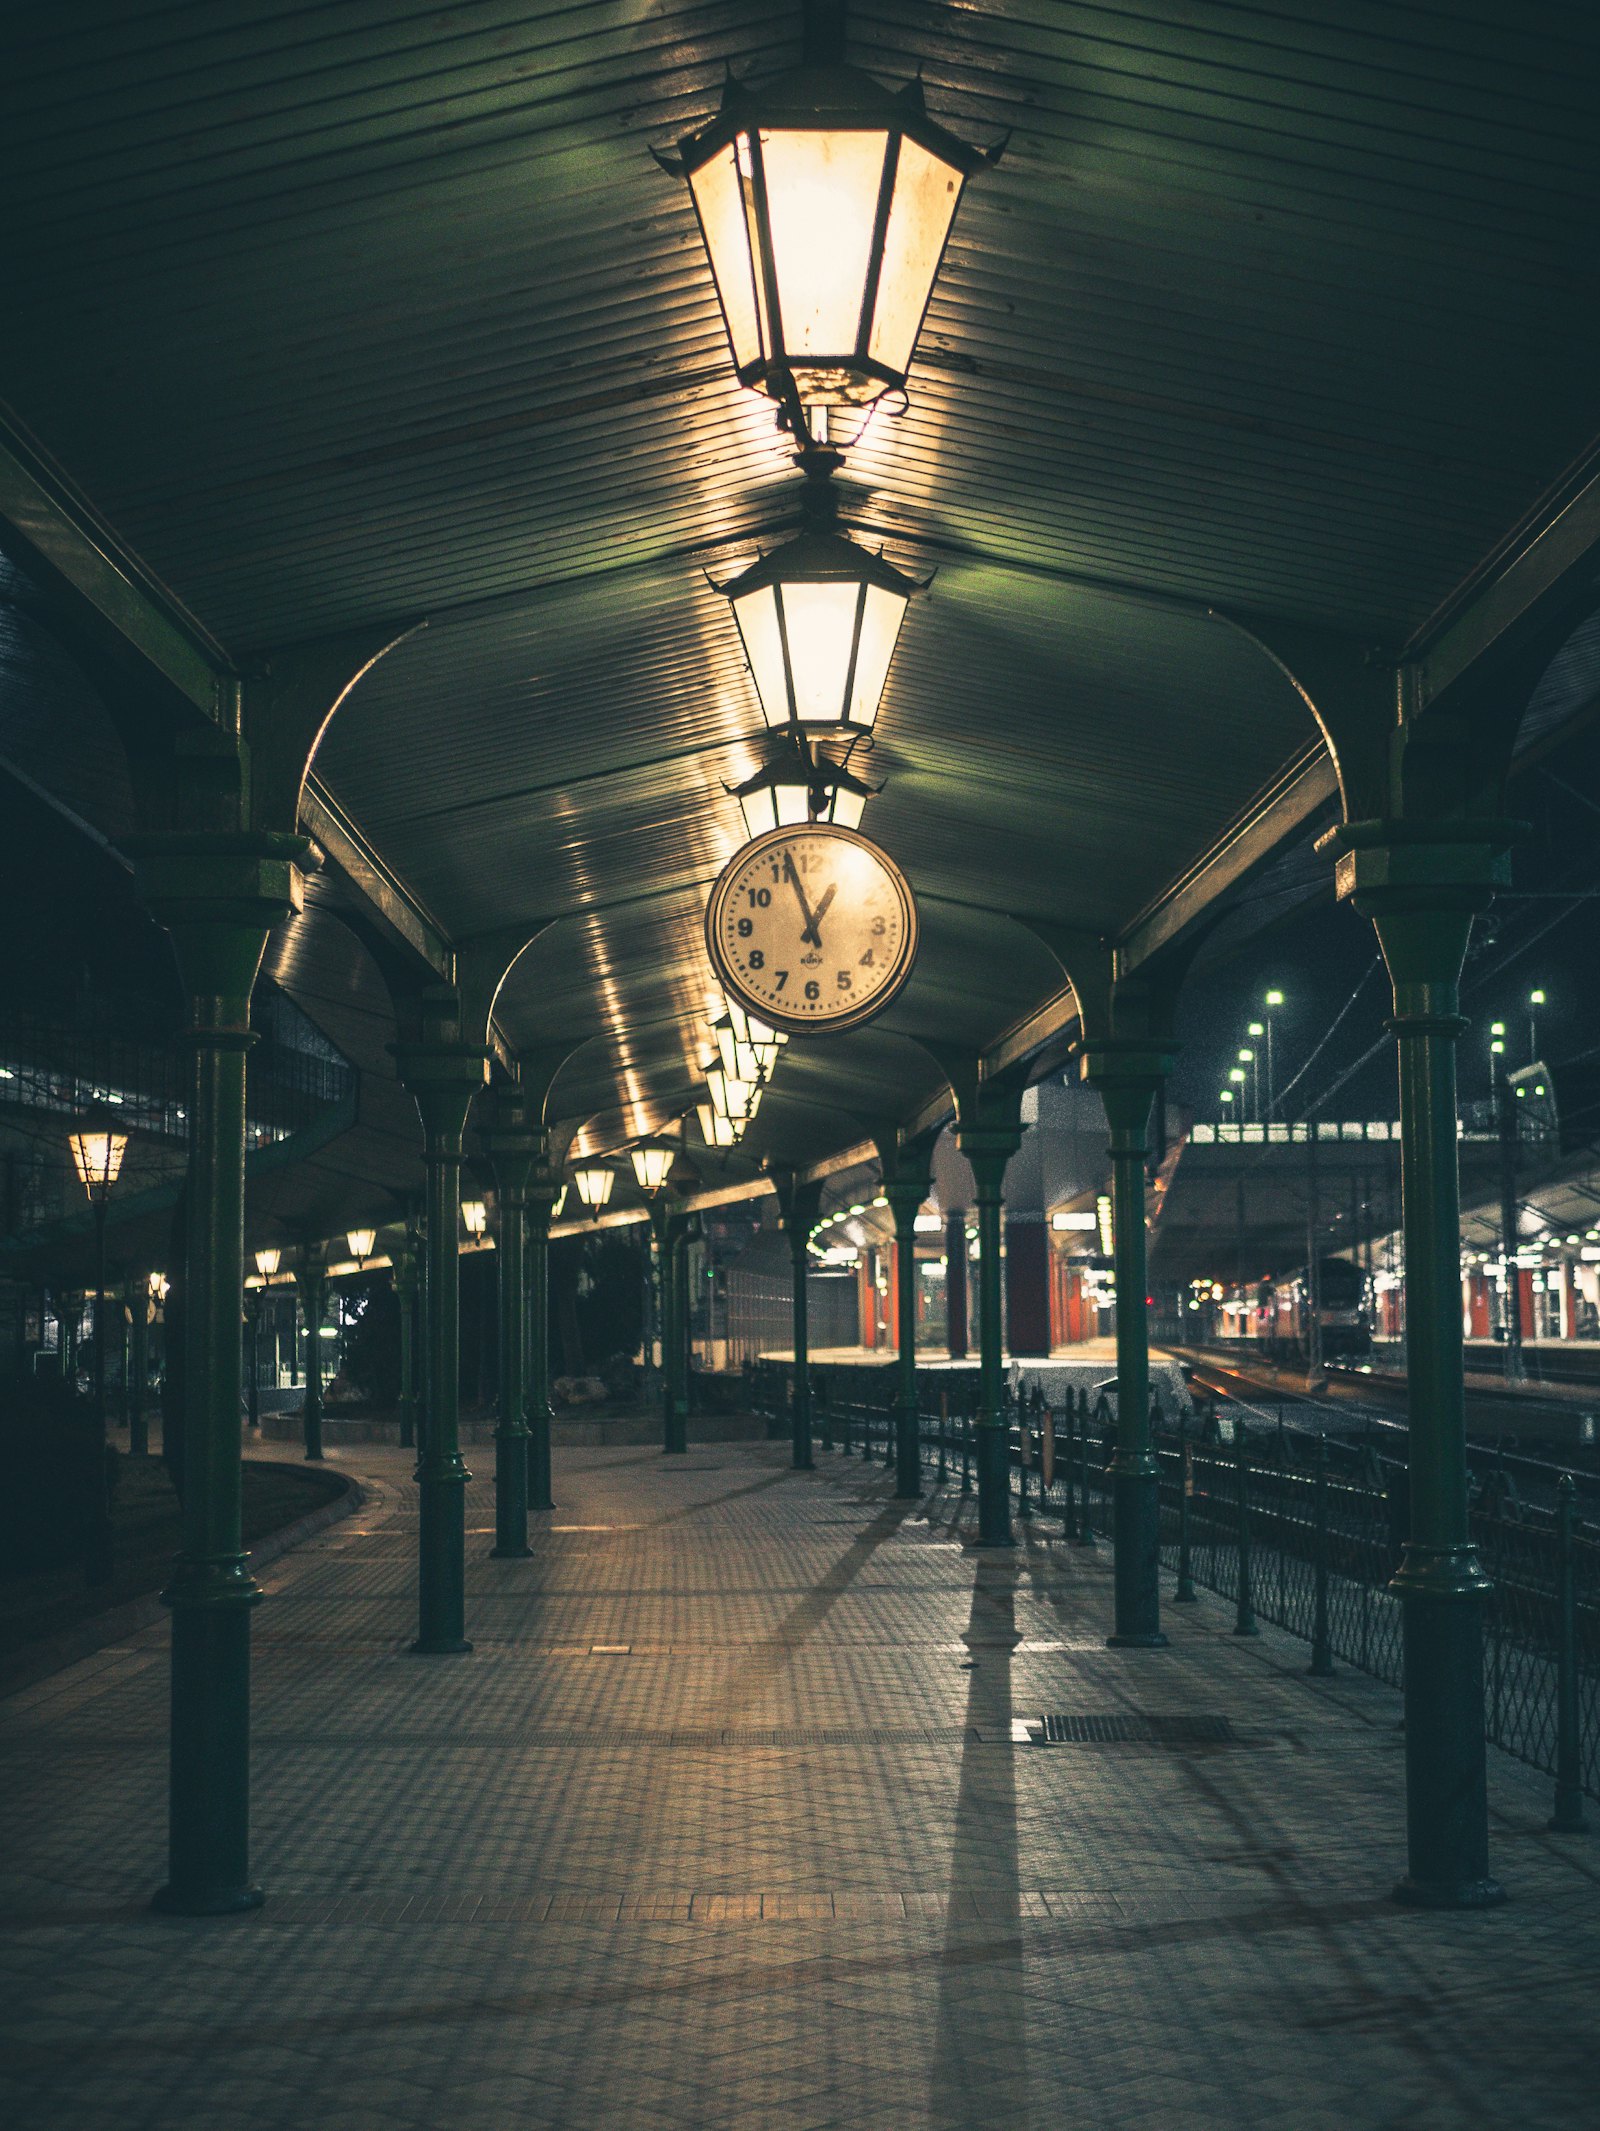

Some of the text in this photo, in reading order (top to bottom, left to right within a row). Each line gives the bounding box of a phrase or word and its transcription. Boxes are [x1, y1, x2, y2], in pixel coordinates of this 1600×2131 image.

[771, 864, 791, 884] 11
[800, 854, 823, 874] 12
[748, 888, 771, 908] 10
[737, 918, 753, 938] 9
[871, 916, 886, 936] 3
[748, 950, 764, 970] 8
[859, 948, 874, 967] 4
[774, 971, 788, 991] 7
[804, 981, 820, 1000] 6
[837, 971, 852, 991] 5
